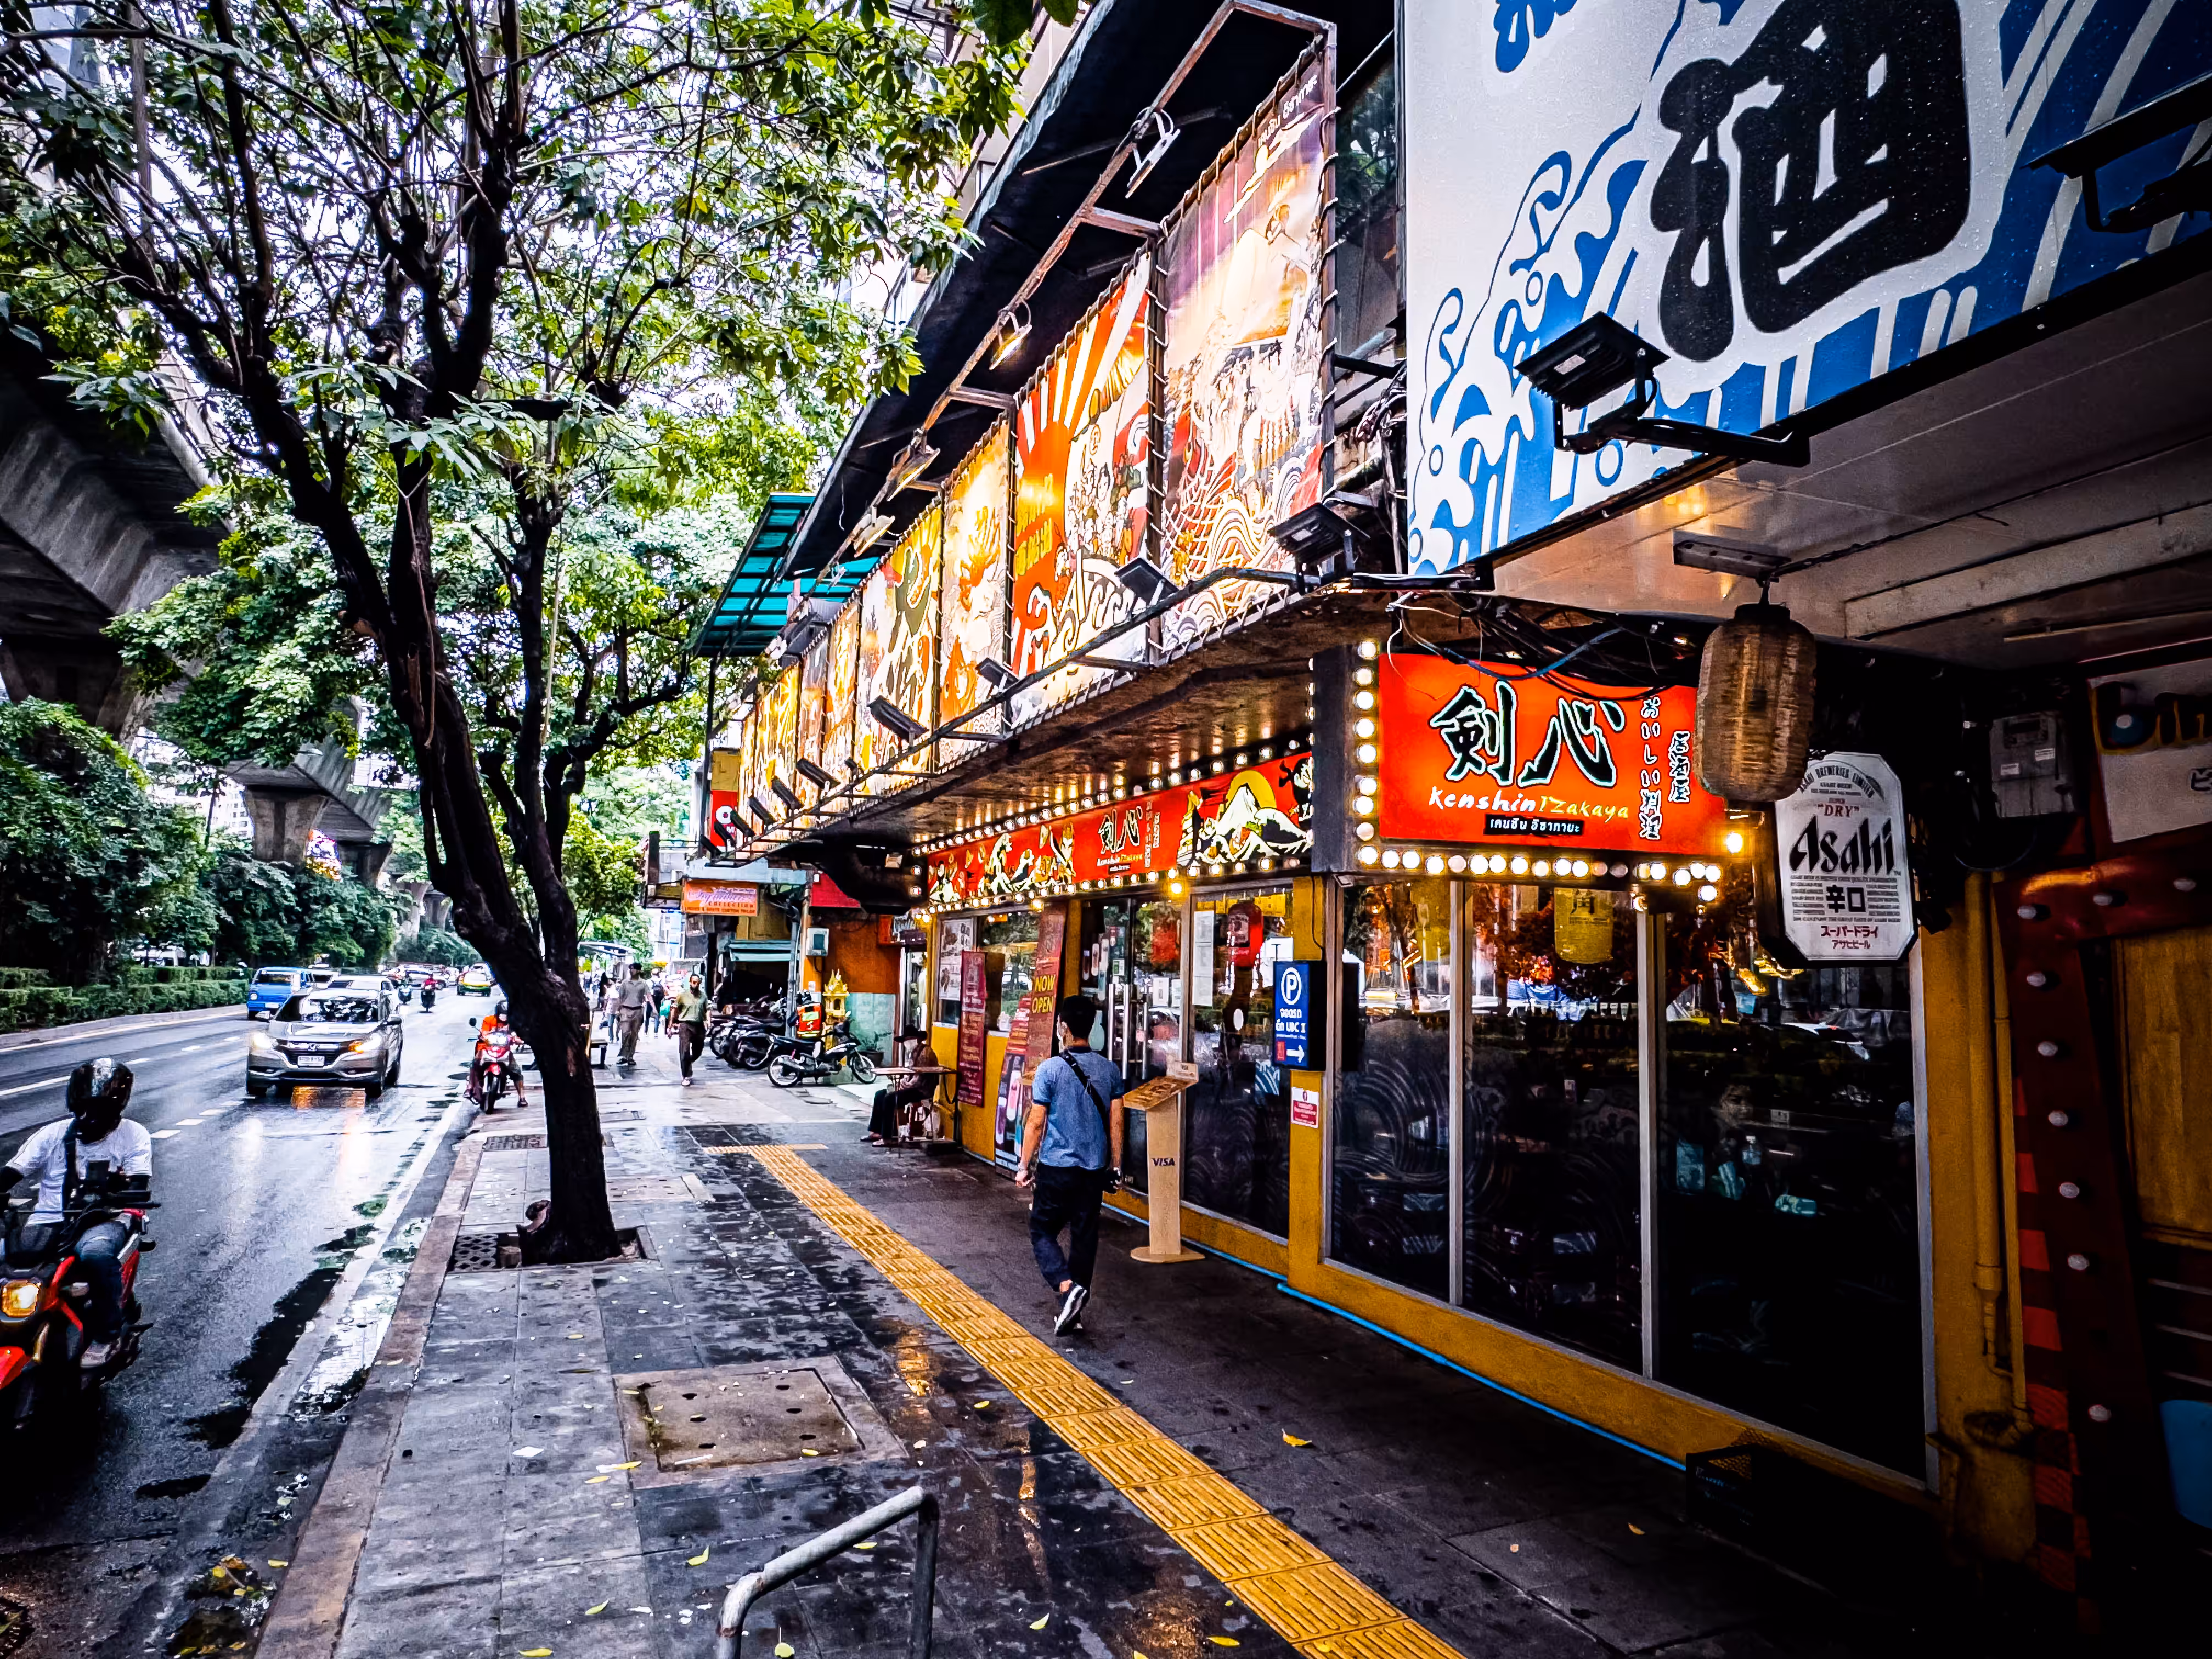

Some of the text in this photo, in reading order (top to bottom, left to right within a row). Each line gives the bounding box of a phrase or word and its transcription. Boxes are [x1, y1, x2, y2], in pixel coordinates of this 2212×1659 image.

[1429, 680, 1626, 787] 剣心
[1668, 731, 1691, 803] 居酒屋
[1429, 786, 1536, 812] Kenshin
[1790, 814, 1895, 875] Asahi
[1826, 884, 1866, 913] 辛口
[1820, 925, 1878, 938] スーパードライ
[1831, 939, 1871, 949] アサヒビール
[1035, 974, 1056, 992] NOW
[1286, 974, 1297, 1000] P
[1031, 996, 1053, 1014] OPEN
[1152, 1158, 1176, 1166] VISA
